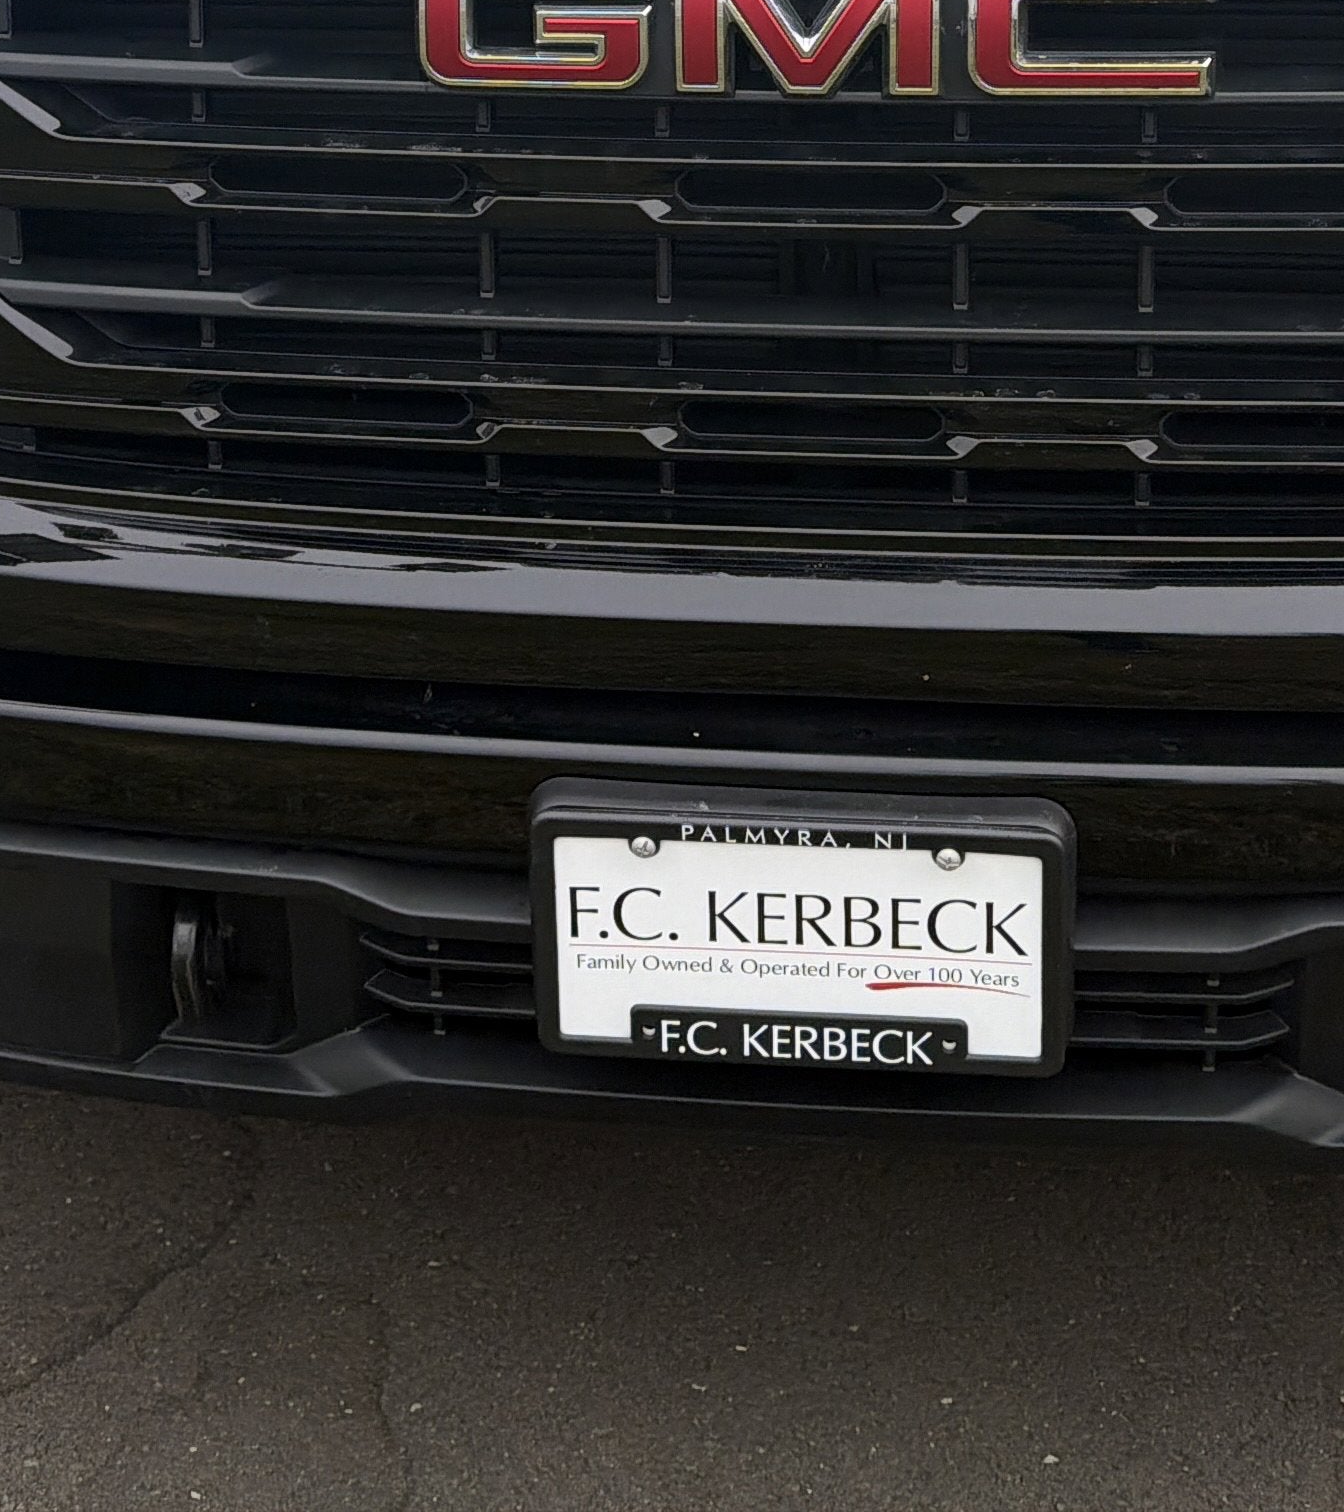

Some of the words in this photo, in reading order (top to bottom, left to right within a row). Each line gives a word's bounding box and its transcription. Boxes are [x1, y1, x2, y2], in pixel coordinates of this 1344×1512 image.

[680, 823, 852, 849] PALMYRA,
[568, 886, 679, 943] F.C.
[707, 889, 1029, 957] KERBECK
[576, 953, 637, 974] Family
[642, 954, 713, 973] Owned
[719, 958, 734, 973] &
[740, 958, 830, 978] Operated
[836, 962, 868, 979] For
[873, 964, 922, 981] Over
[928, 967, 963, 983] 100
[969, 968, 1020, 987] Years
[659, 1019, 728, 1056] F.C.
[741, 1022, 934, 1066] KERBECK
